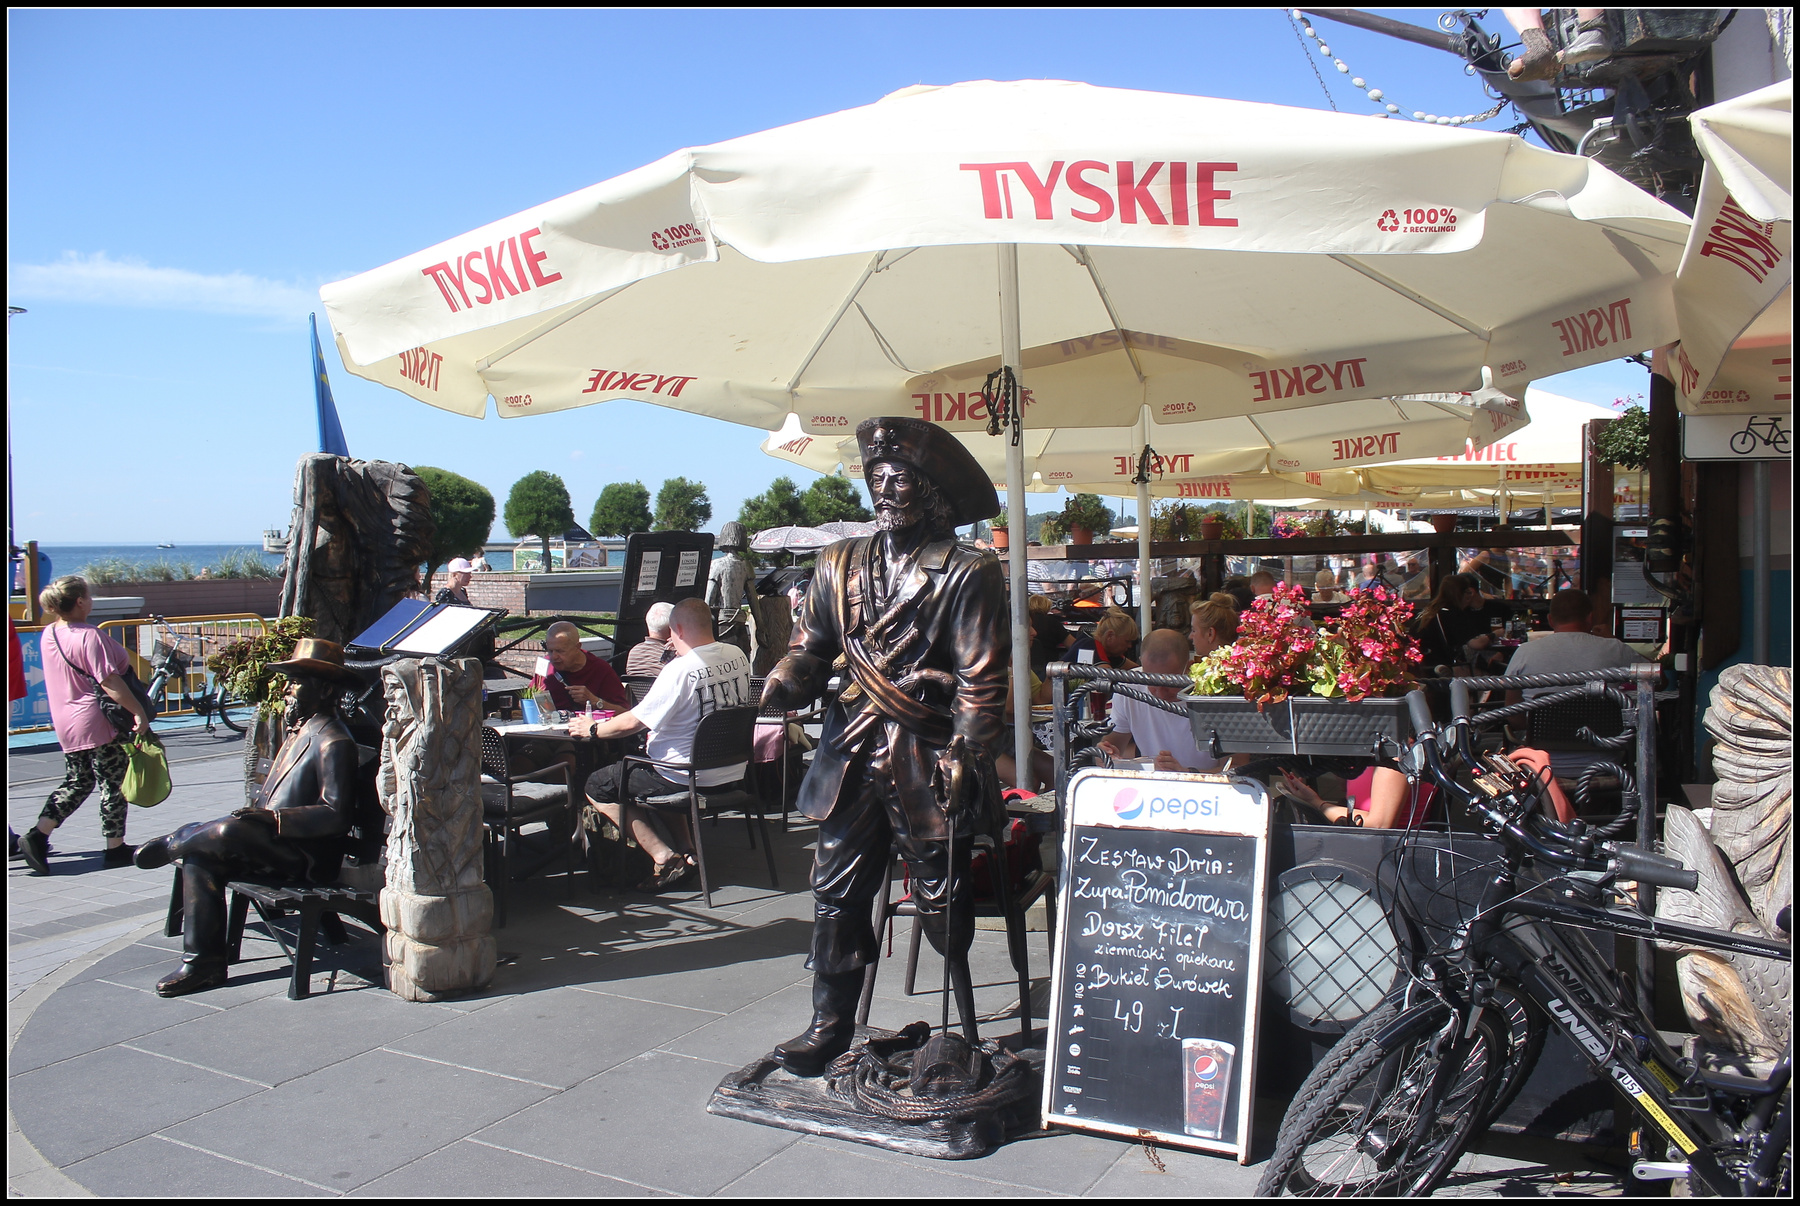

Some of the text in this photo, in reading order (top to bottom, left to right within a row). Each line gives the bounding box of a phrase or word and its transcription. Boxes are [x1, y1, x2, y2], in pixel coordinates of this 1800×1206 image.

[959, 159, 1238, 228] TYSKIE
[1402, 208, 1457, 224] 100%
[664, 222, 702, 241] 100%
[1403, 224, 1457, 233] Z RECYKLINGU
[671, 241, 678, 249] Z
[421, 226, 563, 313] TYSKIE
[1437, 442, 1518, 462] WIEC
[688, 666, 714, 683] SEE
[716, 659, 739, 676] YOU
[1149, 795, 1219, 820] pepsi
[1121, 869, 1250, 923] Pomidorowa
[1081, 911, 1144, 941] Dorsz
[1175, 950, 1236, 972] opiekane
[1087, 963, 1233, 999] Bukiet Surówek
[1113, 999, 1144, 1034] 49
[1194, 1081, 1215, 1090] pepsi
[1620, 1074, 1643, 1096] U57
